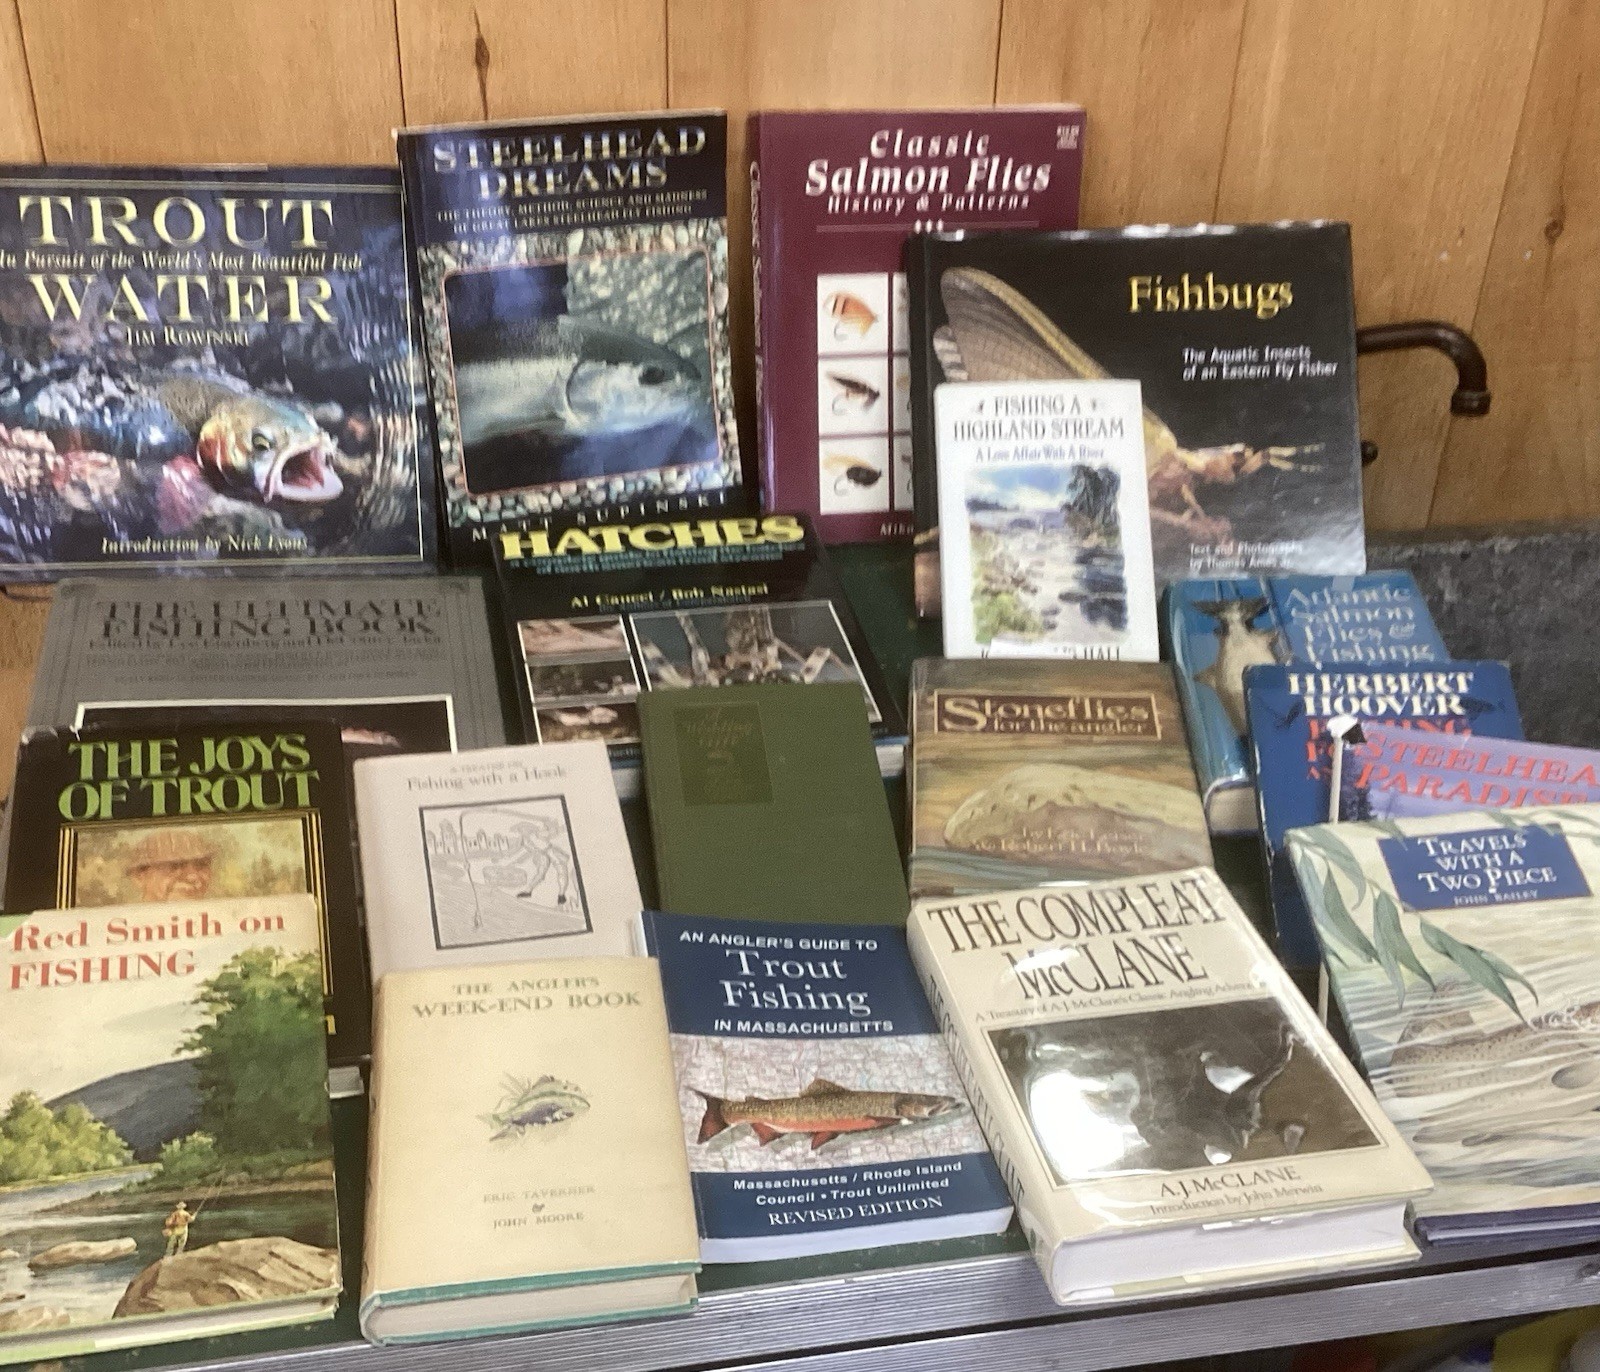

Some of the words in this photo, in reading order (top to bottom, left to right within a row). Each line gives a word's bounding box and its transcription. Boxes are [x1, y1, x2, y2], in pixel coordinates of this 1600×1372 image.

[434, 127, 706, 172] STEELHEAD
[870, 128, 990, 158] Classic
[478, 157, 668, 199] DREAMS
[805, 156, 950, 197] Salmon
[965, 154, 1051, 193] Flies
[828, 193, 906, 216] History
[941, 192, 1030, 212] Patterns
[19, 195, 333, 250] TROUT
[25, 251, 85, 269] Pursuit
[90, 250, 109, 271] of
[111, 250, 135, 268] the
[142, 250, 203, 269] World's
[208, 251, 246, 269] Most
[252, 251, 326, 271] Beautiful
[332, 251, 363, 269] Fish
[25, 273, 339, 323] WATER
[1129, 272, 1294, 319] Fishbugs
[1183, 347, 1206, 365] The
[1211, 346, 1260, 365] Aquatic
[1265, 344, 1312, 362] Insects
[1182, 364, 1198, 381] of
[1201, 365, 1218, 381] an
[1223, 362, 1270, 380] Eastern
[1276, 362, 1295, 380] Fly
[1299, 360, 1339, 377] Fisher
[994, 395, 1065, 416] FISHING
[1070, 394, 1081, 415] A
[953, 419, 1046, 442] HIGHLAND
[1050, 416, 1125, 440] STREAM
[975, 448, 985, 463] A
[102, 536, 200, 554] Introduction
[204, 535, 221, 552] by
[228, 534, 262, 551] Nick
[500, 515, 805, 562] HATCHES
[1285, 582, 1411, 606] Atlantic
[307, 614, 434, 636] BOOK
[1291, 602, 1415, 625] Salmon
[1288, 672, 1474, 695] HERBERT
[944, 697, 1150, 732] Stoneflies
[1303, 692, 1467, 716] HOOVER
[67, 738, 182, 781] THE
[189, 733, 311, 775] JOYS
[58, 779, 130, 822] OF
[140, 769, 321, 816] TROUT
[407, 776, 464, 792] Fishing
[469, 773, 503, 787] with
[509, 773, 518, 784] a
[1417, 832, 1528, 857] TRAVELS
[1435, 852, 1504, 872] WITH
[1509, 850, 1525, 866] A
[1418, 871, 1482, 893] TWO
[1484, 866, 1558, 894] PIECE
[926, 899, 1023, 954] THE
[1015, 877, 1227, 943] COMPLEAT
[13, 920, 88, 952] Red
[106, 911, 222, 946] Smith
[239, 913, 285, 935] on
[680, 930, 704, 943] AN
[708, 932, 794, 949] ANGLER'S
[799, 938, 850, 951] GUIDE
[855, 939, 878, 951] TO
[10, 949, 199, 991] FISHING
[725, 949, 848, 980] Trout
[452, 981, 493, 996] THE
[507, 976, 601, 993] ANGLER'S
[719, 979, 872, 1018] Fishing
[412, 995, 554, 1018] WEEK-END
[567, 990, 641, 1009] BOOK
[714, 1018, 732, 1031] IN
[737, 1018, 894, 1034] MASSACHUSETTS
[733, 1173, 848, 1190] Massachusetts
[852, 1172, 859, 1183] /
[862, 1167, 912, 1182] Rhode
[916, 1160, 963, 1175] Island
[756, 1191, 816, 1206] Council
[830, 1186, 873, 1201] Trout
[876, 1177, 950, 1196] Unlimited
[1150, 1198, 1225, 1217] Introduction
[1226, 1194, 1242, 1208] by
[1243, 1191, 1271, 1206] John
[493, 1216, 527, 1230] JOHN
[536, 1211, 585, 1226] MOORE
[768, 1205, 854, 1227] REVISED
[858, 1194, 944, 1217] EDITION
